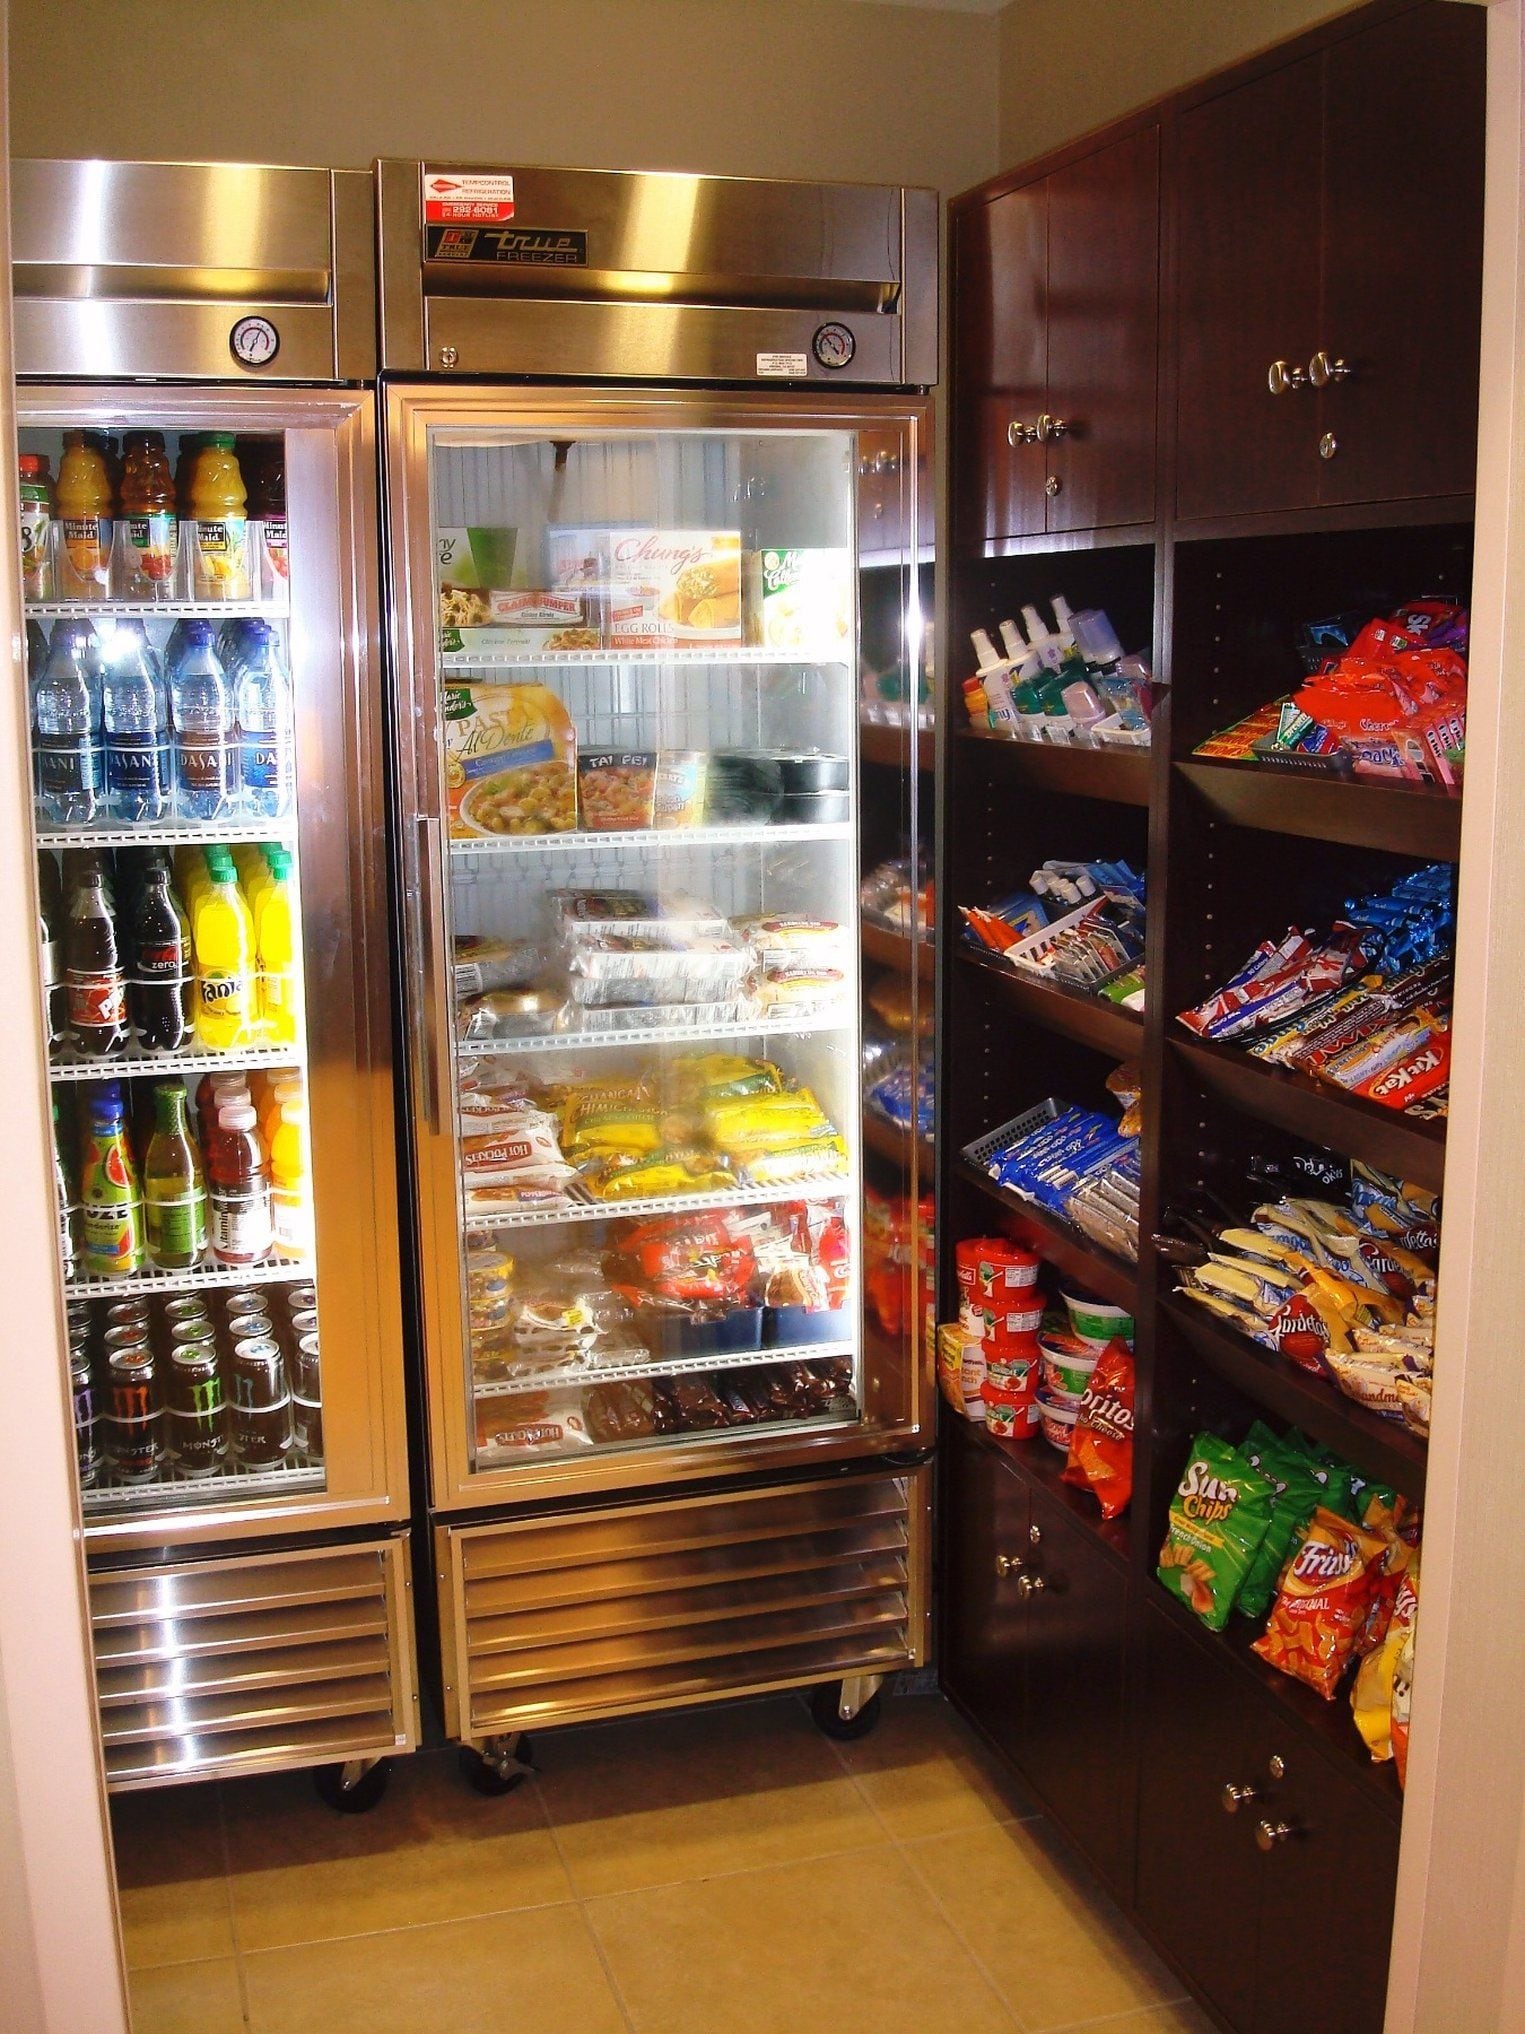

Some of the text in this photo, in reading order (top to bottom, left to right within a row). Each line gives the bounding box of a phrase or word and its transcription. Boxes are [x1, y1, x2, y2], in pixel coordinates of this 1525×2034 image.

[496, 251, 577, 263] FREEZER
[65, 521, 98, 531] Minute
[68, 531, 94, 539] Maid
[614, 535, 708, 576] Chung's
[614, 622, 639, 634] EGG
[180, 752, 232, 770] DASAI
[589, 755, 613, 768] TAI
[151, 959, 177, 969] zero
[465, 1148, 508, 1165] POCKETS
[1177, 1461, 1238, 1503] Sun
[1183, 1494, 1233, 1526] Chips
